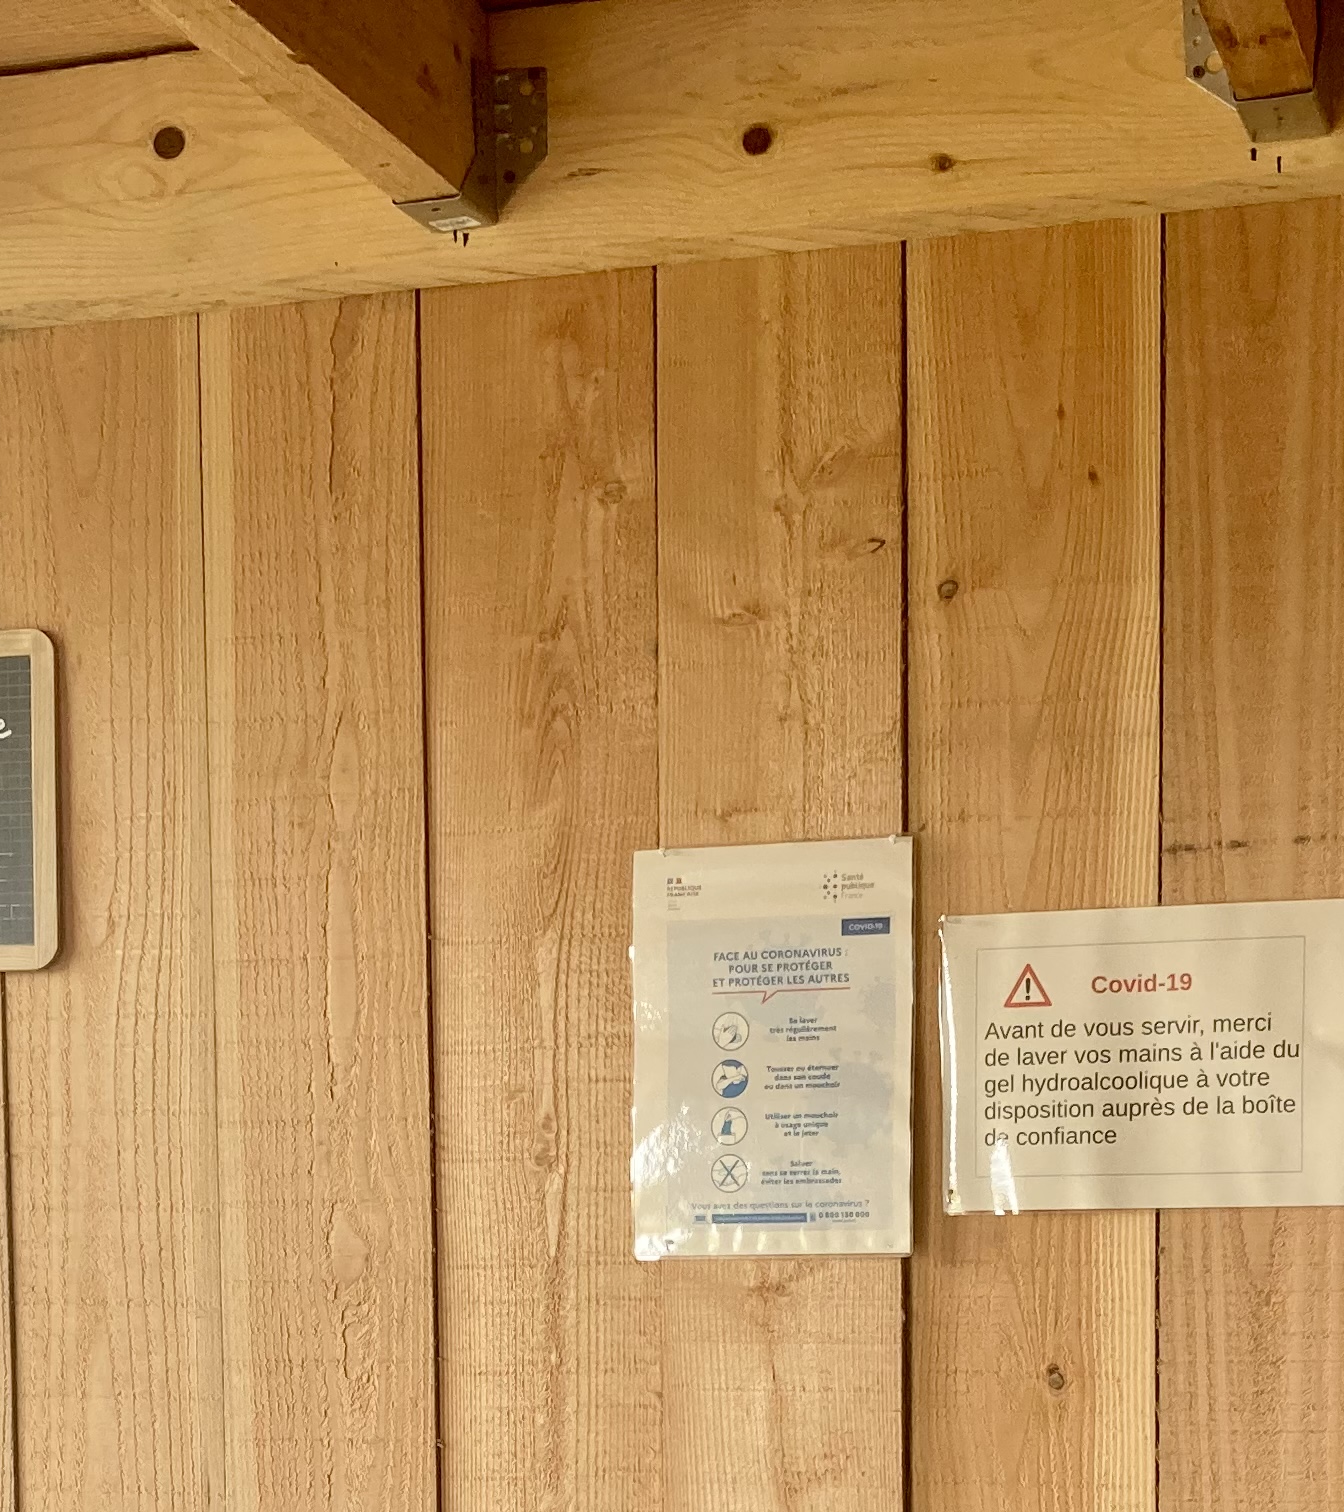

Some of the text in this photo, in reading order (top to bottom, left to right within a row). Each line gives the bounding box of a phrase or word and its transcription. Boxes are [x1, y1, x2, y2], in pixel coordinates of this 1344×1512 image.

[714, 952, 739, 961] FACE
[743, 951, 758, 960] AU
[761, 948, 842, 960] CORONAVIRUS
[729, 960, 832, 974] POUR SE PROTÉGER
[713, 973, 850, 988] ET PROTÉGER LES AUTRES
[1091, 973, 1192, 994] Covid-19
[984, 1012, 1272, 1040] Avant de vous servir, merci
[984, 1040, 1300, 1066] de laver vos mains à l'aide du
[984, 1069, 1270, 1098] gel hydroalcoolique à votre
[984, 1094, 1296, 1123] disposition auprès de la boîte
[1016, 1126, 1117, 1145] confiance
